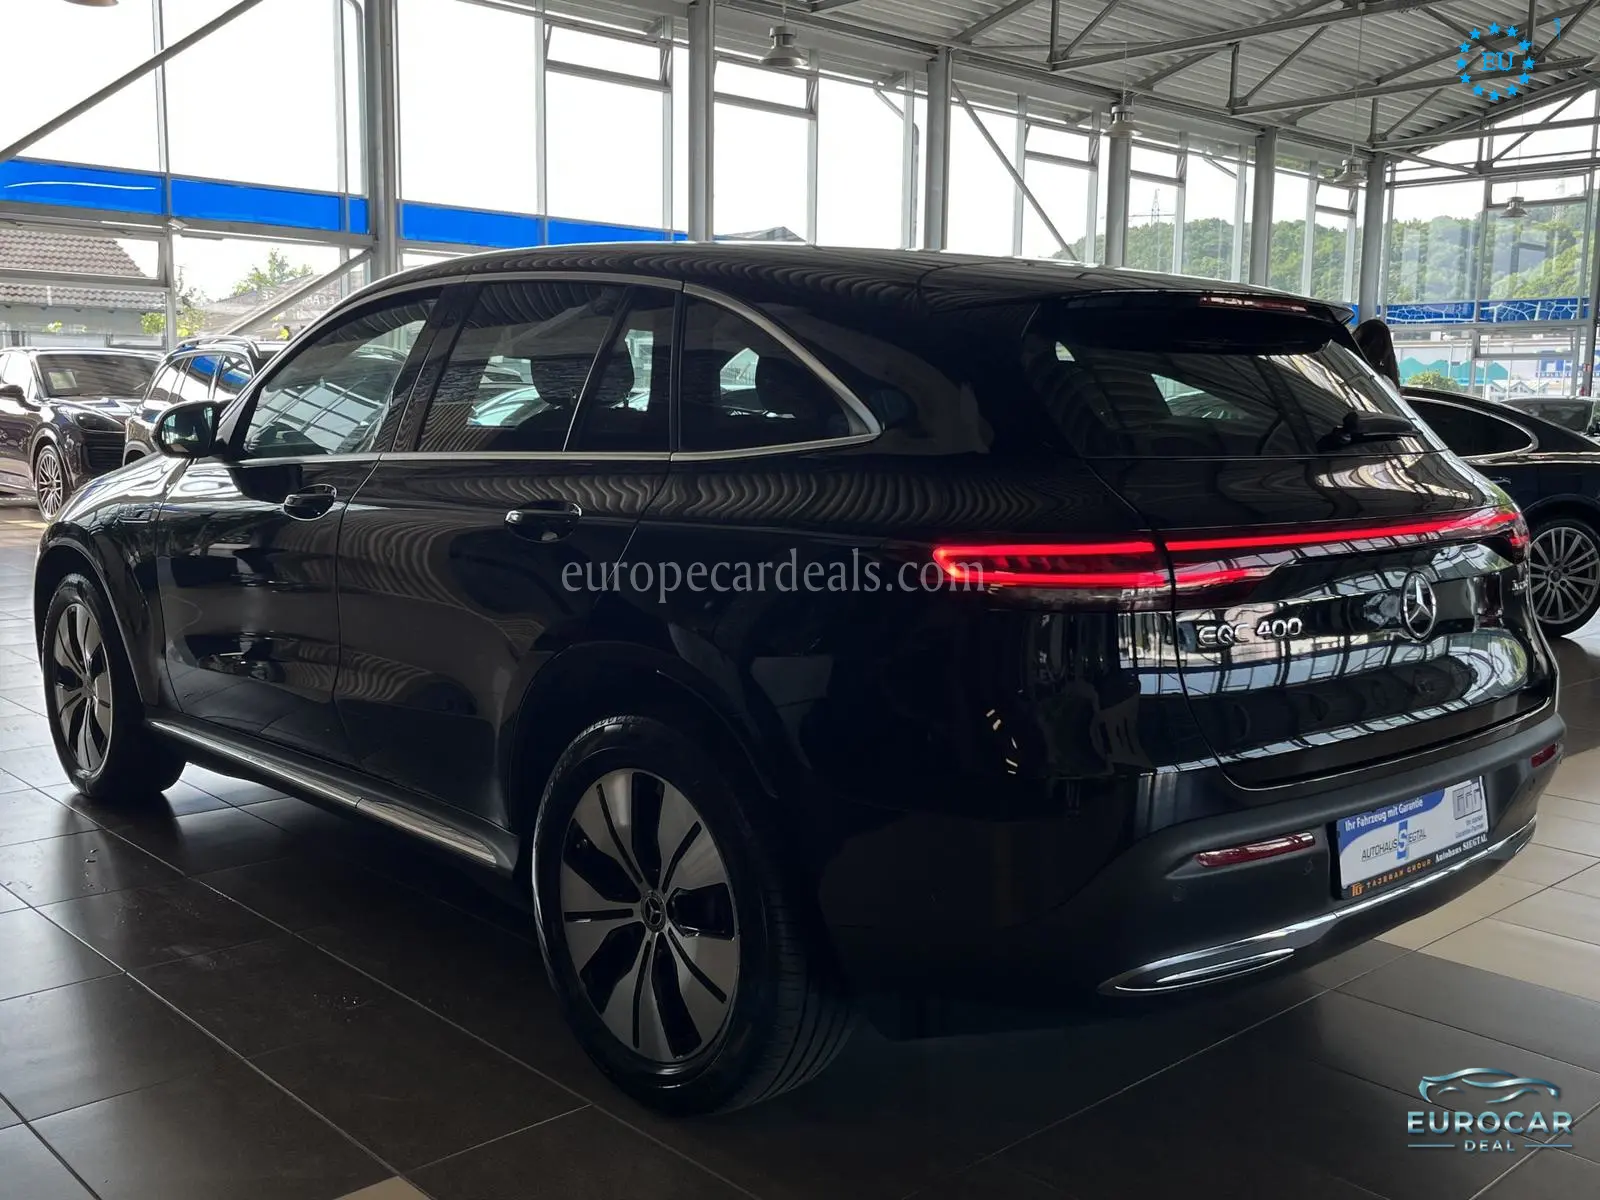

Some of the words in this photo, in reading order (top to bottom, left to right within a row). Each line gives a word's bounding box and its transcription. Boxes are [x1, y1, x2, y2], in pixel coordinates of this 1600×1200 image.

[1197, 623, 1250, 647] EQC
[1256, 617, 1302, 638] 400
[1345, 819, 1356, 832] Ihr
[1356, 811, 1387, 828] Fahrzeug
[1387, 806, 1398, 817] mit
[1398, 797, 1424, 814] Garantie
[1361, 838, 1398, 860] AUTOHAUS
[1435, 846, 1462, 864] Autohaus
[1462, 833, 1488, 851] SIEGTAL
